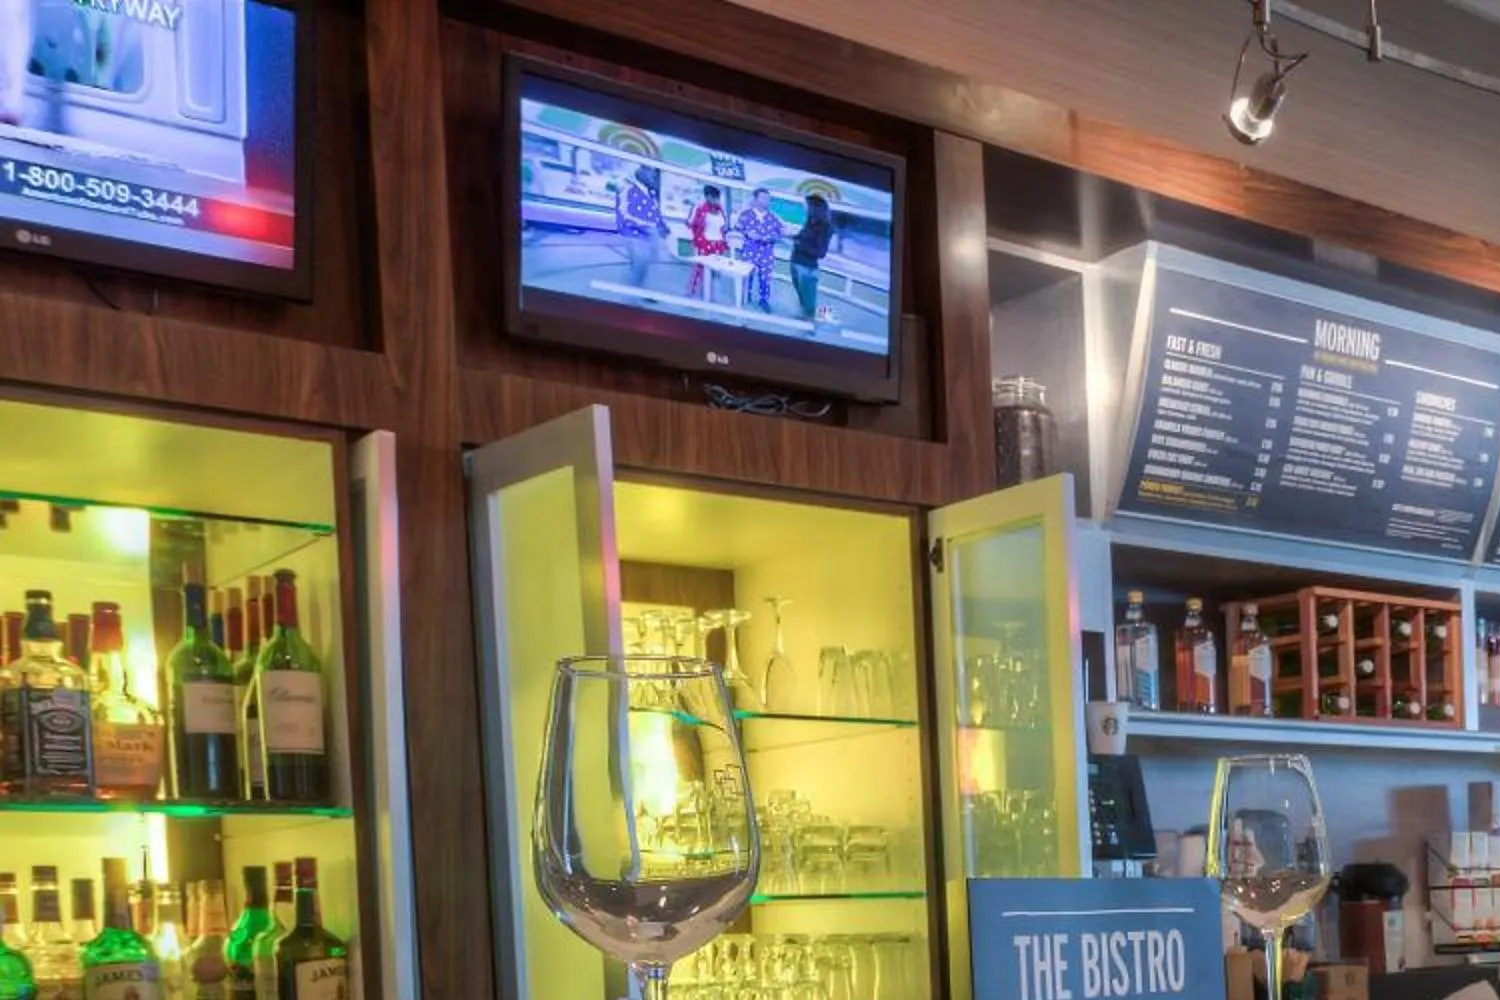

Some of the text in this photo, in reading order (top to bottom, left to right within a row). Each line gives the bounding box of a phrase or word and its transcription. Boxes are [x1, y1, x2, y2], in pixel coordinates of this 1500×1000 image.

[3, 160, 199, 217] 1-800-509-3444
[1314, 318, 1381, 361] MORNING
[1081, 929, 1185, 999] BISTRO
